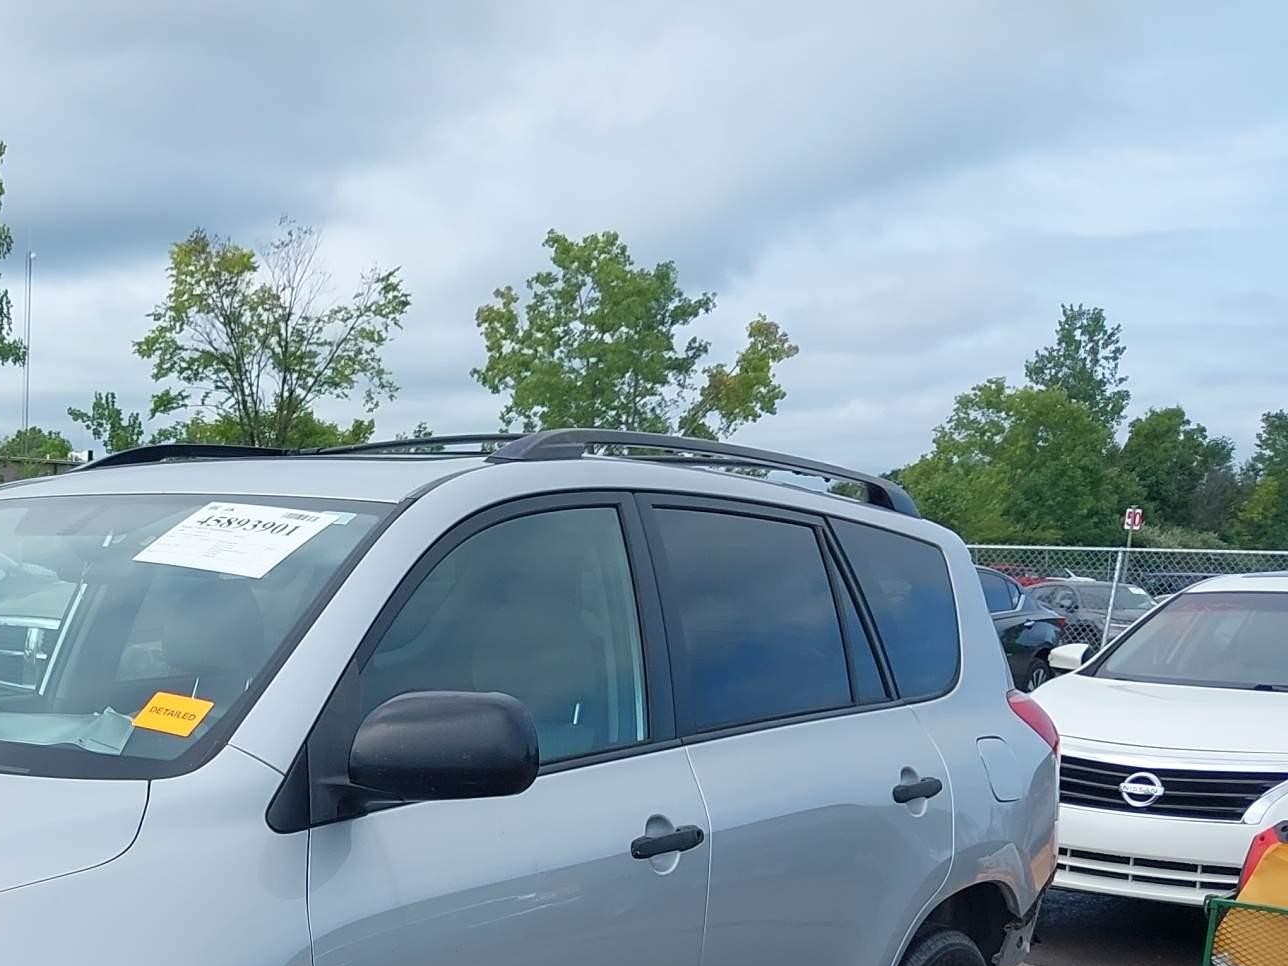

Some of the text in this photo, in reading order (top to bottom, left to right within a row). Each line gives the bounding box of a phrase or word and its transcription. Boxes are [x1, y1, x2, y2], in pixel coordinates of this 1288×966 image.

[196, 515, 302, 537] 45893901
[149, 705, 197, 721] DETAILED
[1122, 785, 1159, 794] NISSAN
